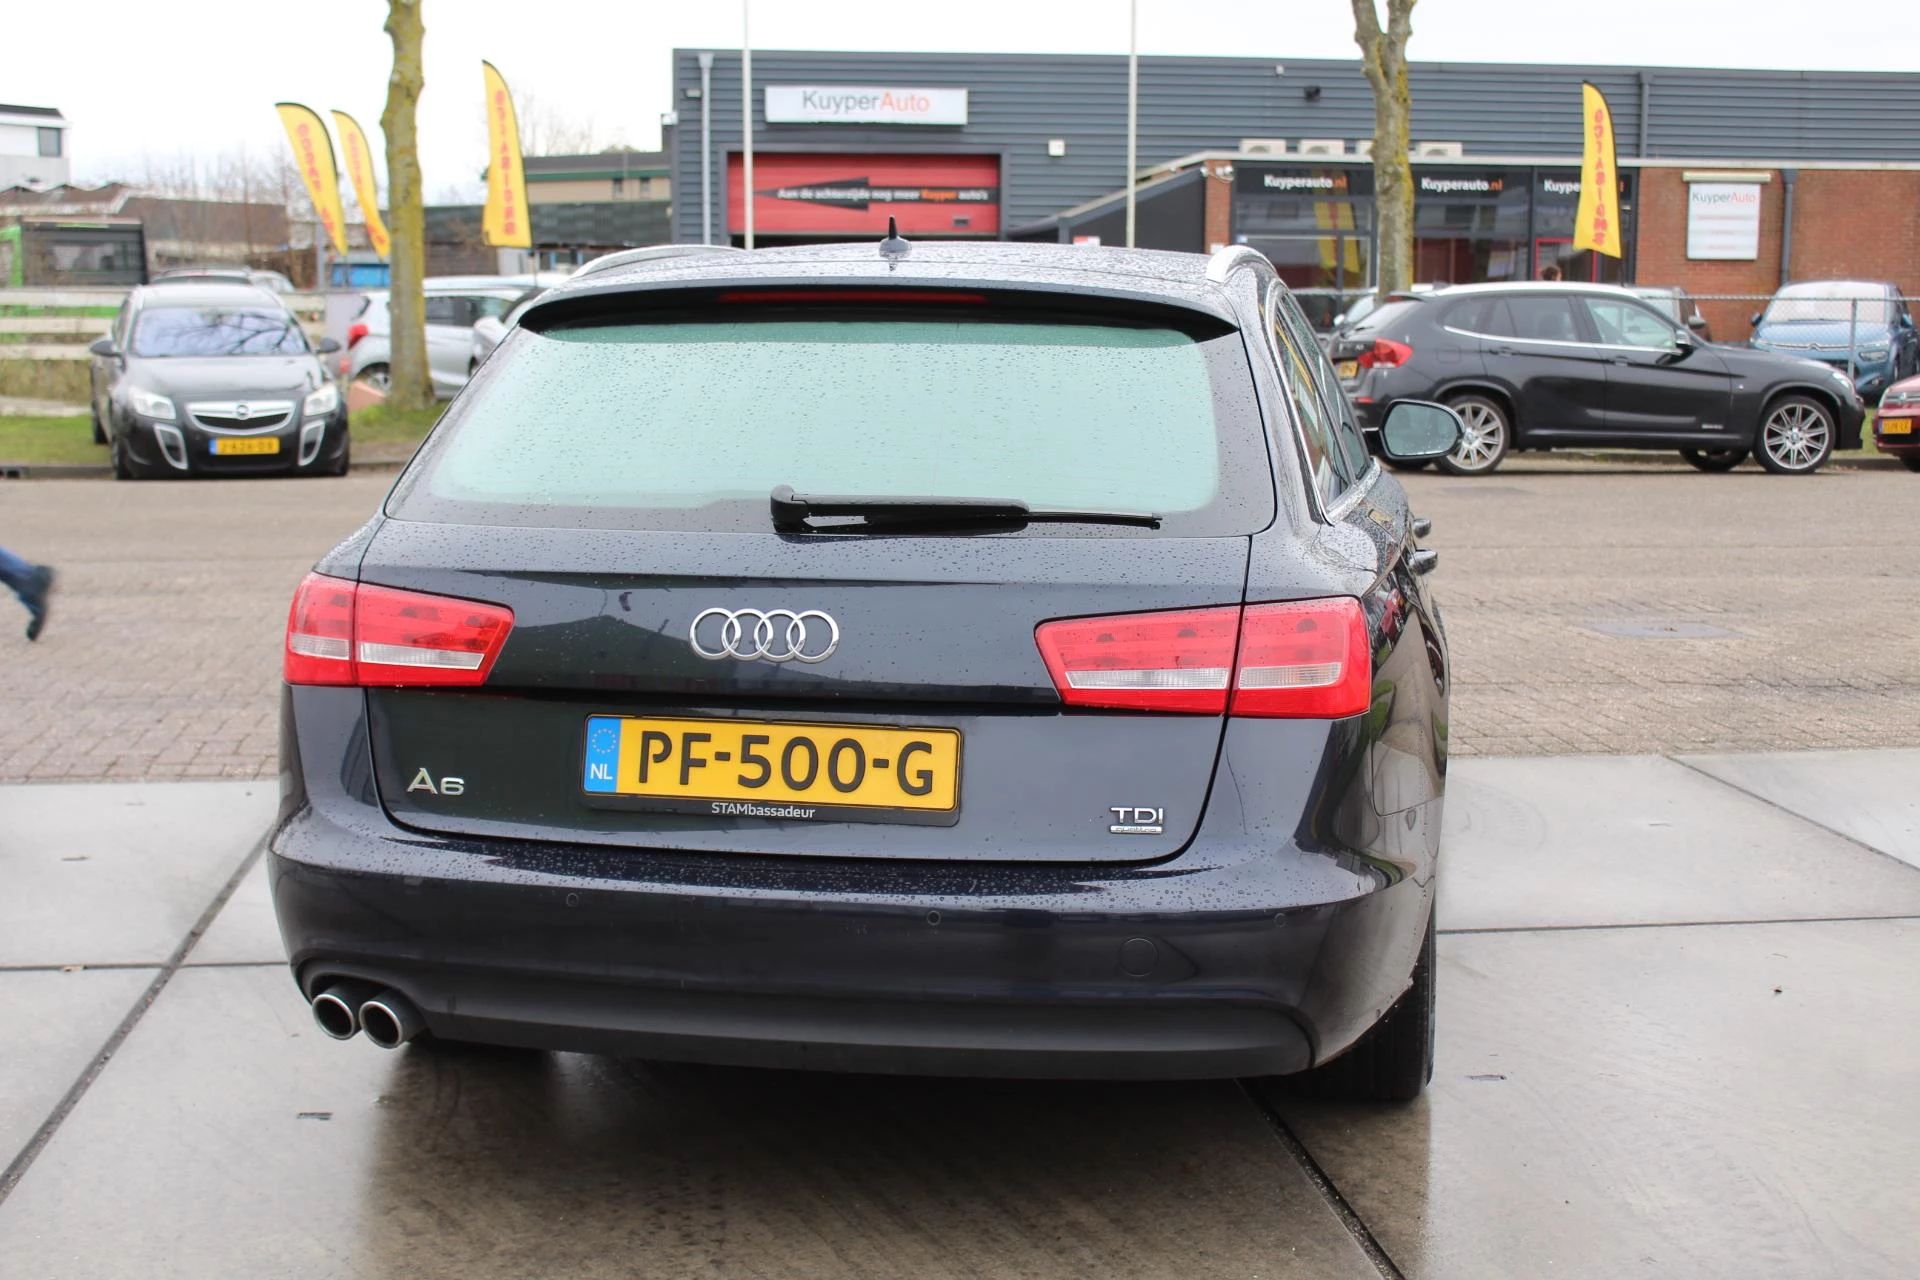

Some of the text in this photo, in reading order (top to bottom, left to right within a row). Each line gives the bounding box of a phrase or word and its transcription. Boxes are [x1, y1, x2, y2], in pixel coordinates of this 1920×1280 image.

[802, 90, 930, 113] KuyperAuto
[1263, 174, 1347, 190] Kuyperauto.nl
[1421, 177, 1504, 192] Kuyperauto.nl
[1692, 192, 1756, 204] KuyperAuto
[590, 731, 934, 796] NL PF-500-G
[407, 768, 465, 795] A6
[711, 802, 816, 818] STAMbassadeur
[1110, 807, 1164, 824] TDI
